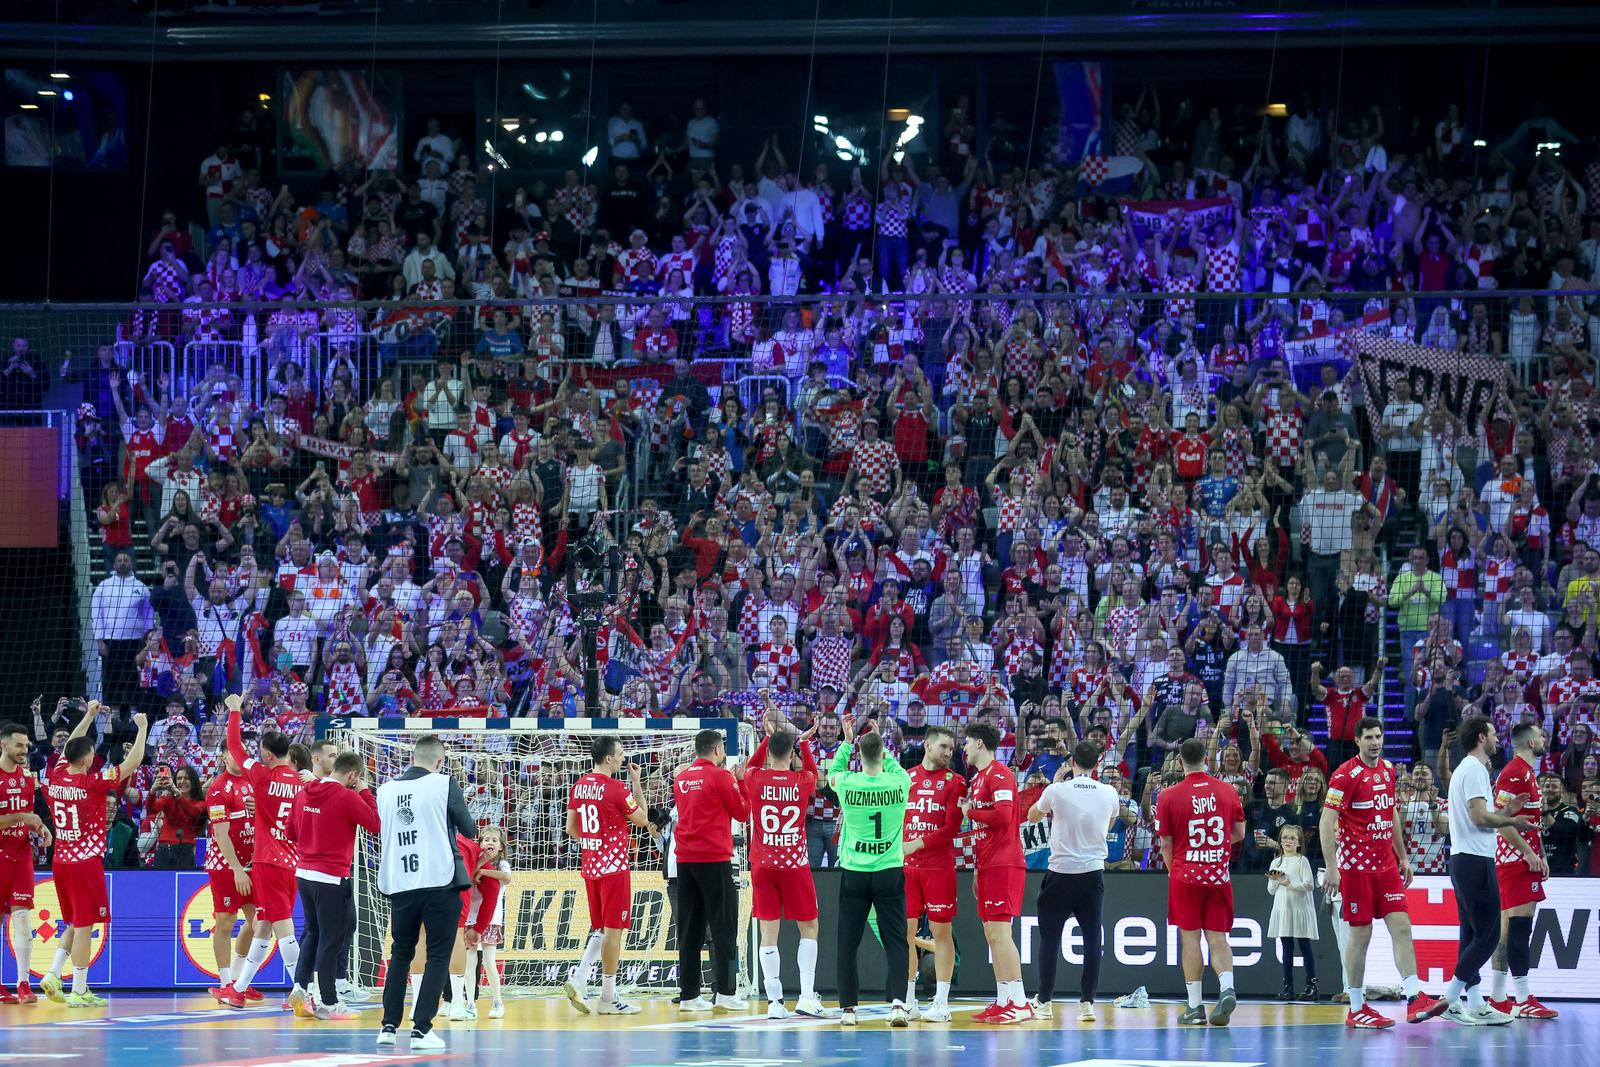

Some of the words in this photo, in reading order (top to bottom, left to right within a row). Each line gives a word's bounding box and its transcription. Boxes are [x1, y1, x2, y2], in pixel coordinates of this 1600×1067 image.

[1302, 343, 1319, 357] RK
[9, 796, 20, 810] 11
[761, 784, 799, 801] JELINIĆ
[845, 785, 904, 806] KUZMANOVIĆ
[1374, 793, 1388, 810] 30
[915, 797, 932, 813] 41
[1192, 793, 1216, 815] ŠIPIĆ
[54, 801, 79, 829] 51
[577, 804, 600, 834] 18
[761, 805, 800, 834] 62
[869, 811, 881, 840] 1
[1188, 816, 1224, 848] 53
[1418, 821, 1425, 834] 8
